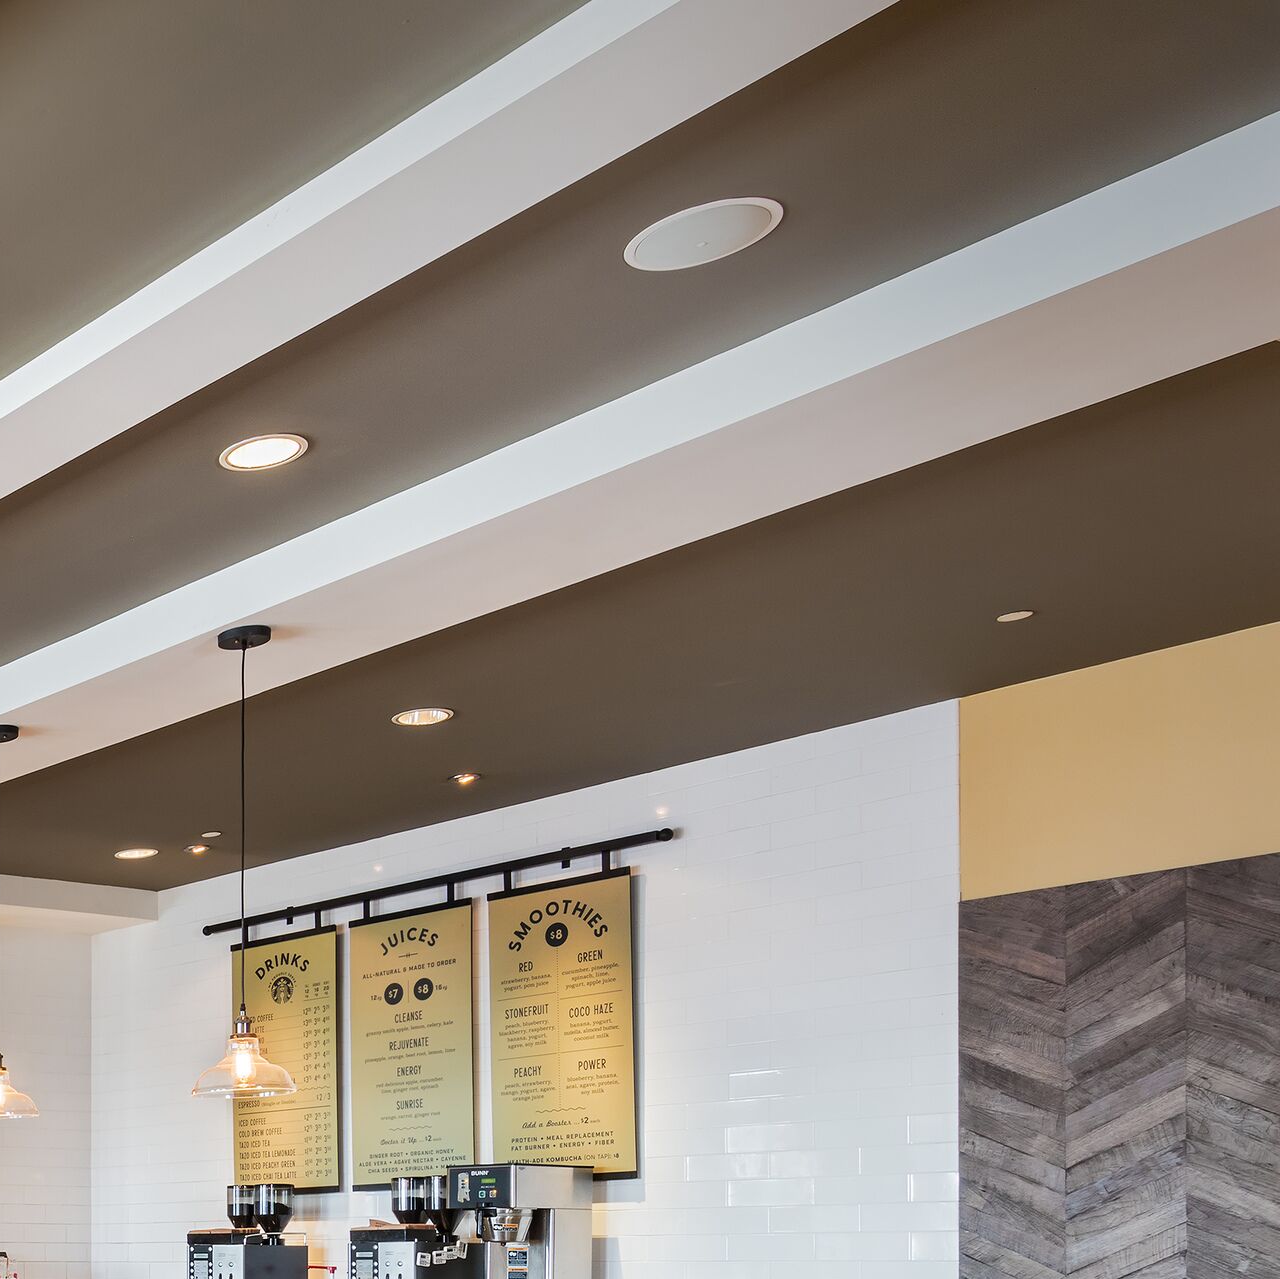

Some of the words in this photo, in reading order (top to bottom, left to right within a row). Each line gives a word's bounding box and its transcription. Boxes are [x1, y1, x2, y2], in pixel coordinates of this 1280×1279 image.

[508, 900, 608, 952] SMOOTHIES
[550, 929, 563, 940] $8
[380, 927, 439, 956] JUICES
[577, 949, 603, 963] GREEN
[255, 952, 310, 980] DRINKS
[363, 967, 401, 979] ALL-NATURAL
[437, 958, 457, 967] ORDER
[519, 961, 533, 973] RED
[590, 962, 620, 973] pineapple,
[500, 976, 530, 986] strawberry,
[535, 980, 549, 988] juice
[586, 980, 601, 988] apple
[602, 977, 616, 985] juice
[388, 989, 399, 999] $7
[417, 984, 429, 994] $8
[505, 1003, 549, 1020] STONEFRUIT
[568, 1005, 590, 1019] COCO
[593, 1002, 614, 1015] HAZE
[257, 1013, 274, 1023] COFFEE
[395, 1010, 423, 1024] CLEANSE
[389, 1036, 429, 1051] REJUVENATE
[578, 1058, 607, 1071] POWER
[397, 1065, 422, 1077] ENERGY
[514, 1066, 542, 1078] PEACHY
[238, 1100, 260, 1109] ESPRESSO
[396, 1098, 423, 1110] SUNRISE
[239, 1119, 248, 1127] ICED
[250, 1117, 266, 1126] COFFEE
[522, 1121, 536, 1129] Add
[546, 1119, 572, 1128] Booster
[252, 1129, 264, 1137] BREW
[266, 1128, 282, 1136] COFFEE
[566, 1131, 614, 1139] REPLACEMENT
[251, 1140, 260, 1148] ICED
[524, 1143, 550, 1151] BURNER
[560, 1141, 585, 1149] ENERGY
[251, 1151, 260, 1159] ICED
[262, 1150, 270, 1158] TEA
[272, 1149, 295, 1157] LEMONADE
[546, 1155, 582, 1163] KOMBUCHA
[251, 1162, 261, 1170] ICED
[263, 1161, 279, 1169] PEACHY
[281, 1160, 295, 1168] GREEN
[405, 1164, 433, 1172] SPIRULINA
[251, 1173, 261, 1181] ICED
[263, 1172, 273, 1180] CHAI
[284, 1171, 296, 1179] LATTE
